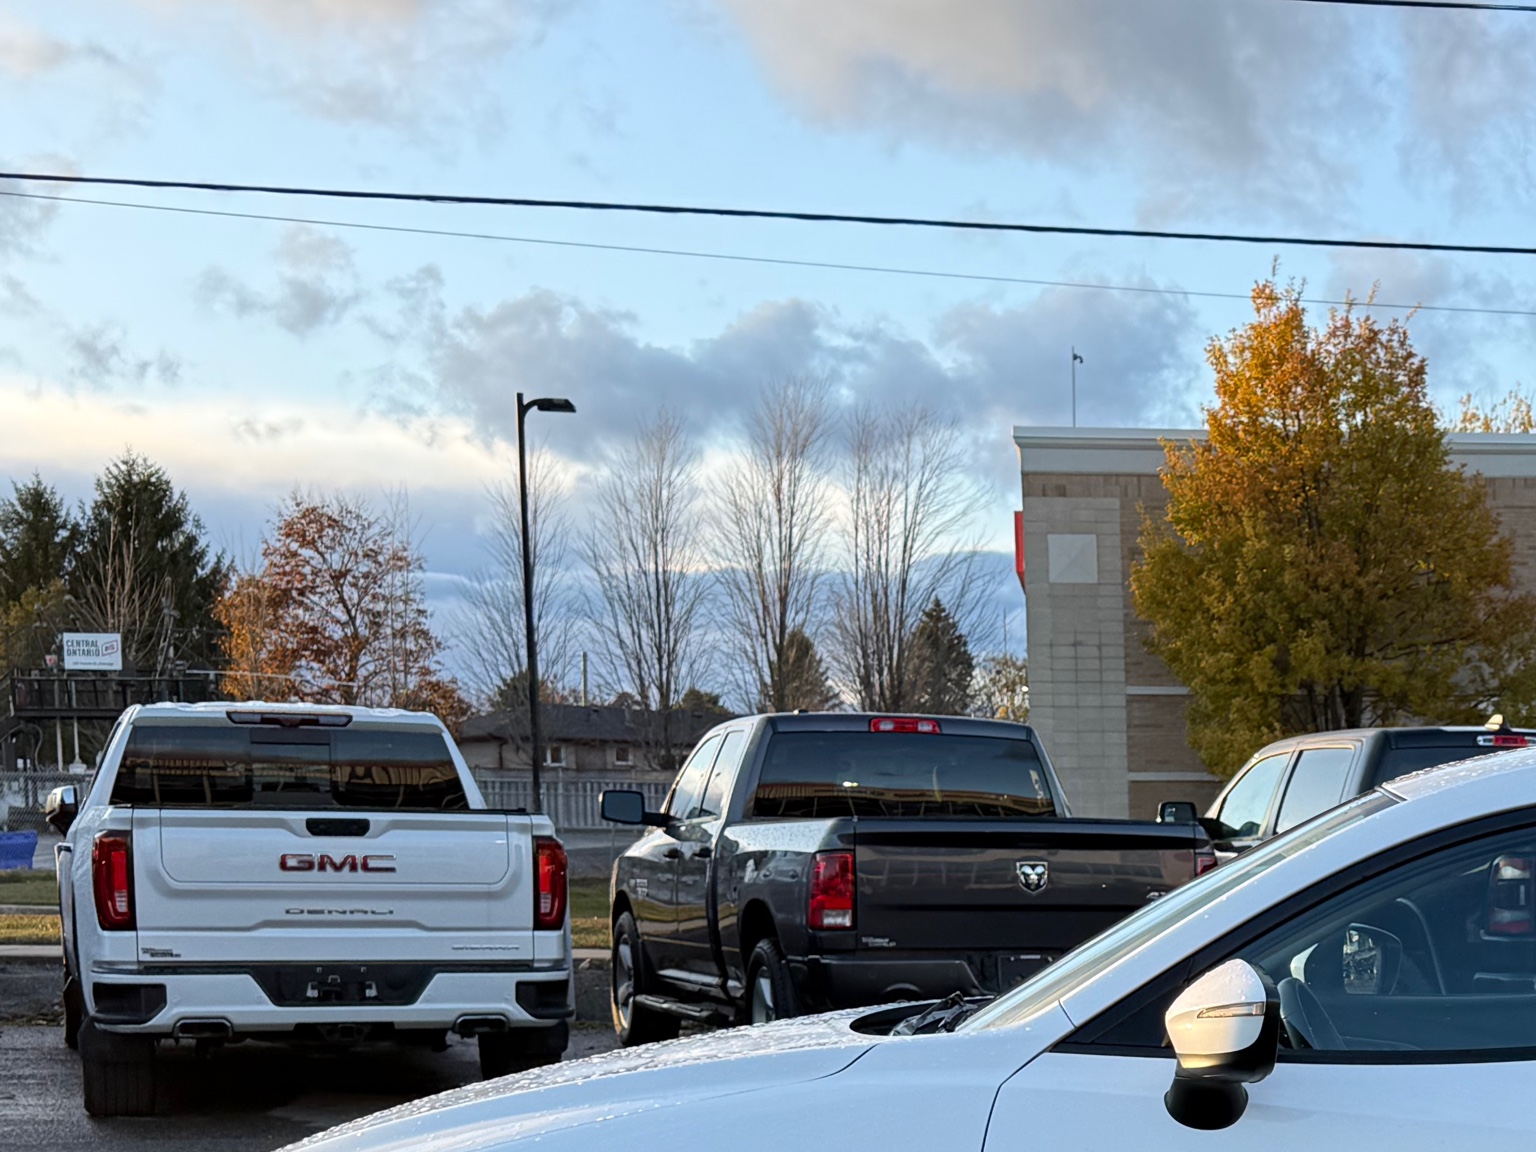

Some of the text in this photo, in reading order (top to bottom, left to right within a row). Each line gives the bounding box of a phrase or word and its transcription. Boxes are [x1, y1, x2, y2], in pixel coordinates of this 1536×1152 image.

[66, 639, 98, 648] CENTRAL
[66, 648, 100, 657] ONTARIO
[279, 853, 397, 873] GMC
[285, 907, 394, 915] DENALI
